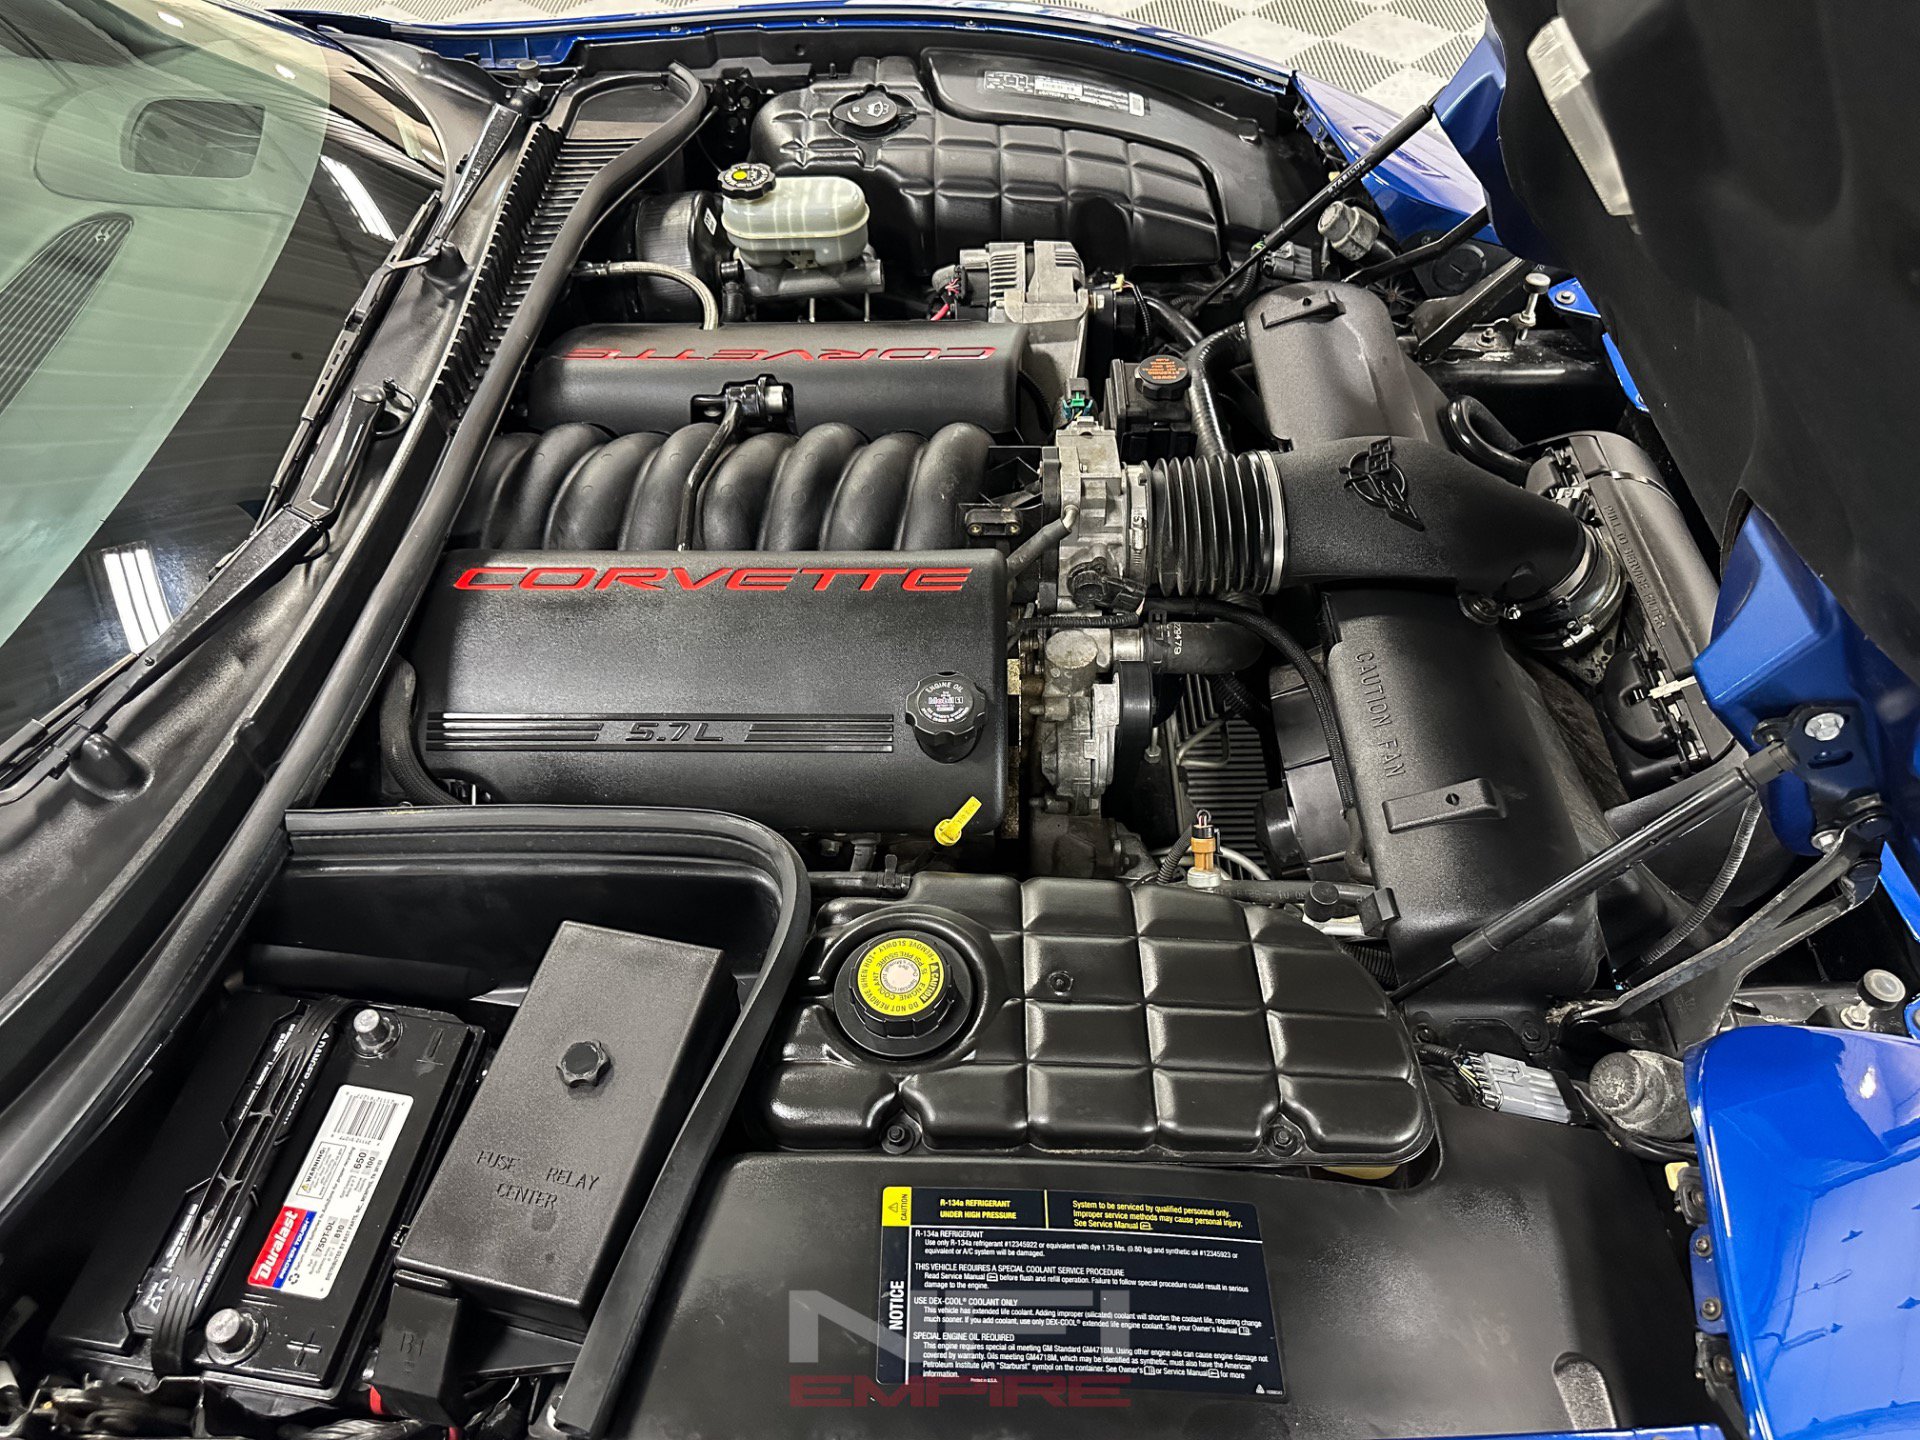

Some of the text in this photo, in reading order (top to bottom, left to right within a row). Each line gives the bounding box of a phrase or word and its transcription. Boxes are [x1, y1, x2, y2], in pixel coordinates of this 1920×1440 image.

[1327, 159, 1367, 193] STABILUS
[561, 347, 996, 362] CORVETTE
[1603, 503, 1621, 531] PULL
[1621, 547, 1649, 592] SERVICE
[1643, 591, 1668, 631] FILTER
[452, 566, 973, 592] CORVETTE
[925, 682, 964, 693] ENGINE OIL
[1354, 651, 1407, 779] CAUTION FAN
[624, 722, 724, 743] 5.7L
[879, 940, 935, 959] REMOVE SLOWLY
[864, 955, 875, 968] HOT
[876, 951, 914, 968] PRESSURE
[873, 972, 896, 1001] COOLANT
[900, 982, 926, 1001] ENGINE
[921, 972, 940, 1002] CAUTION
[864, 989, 890, 1011] REMOVE
[908, 1001, 919, 1010] DO
[305, 1146, 326, 1182] WARNING:
[476, 1151, 600, 1191] FUSE RELAY
[315, 1219, 335, 1252] 75DT-DL
[352, 1151, 368, 1169] 650
[333, 1155, 376, 1238] 810 100
[496, 1183, 558, 1210] CENTER
[965, 1200, 1010, 1208] REFRIGERANT
[900, 1193, 908, 1222] CAUTION
[981, 1211, 1016, 1219] PRESSURE
[1072, 1201, 1097, 1210] System
[1116, 1203, 1144, 1211] serviced
[1145, 1205, 1153, 1213] by
[1154, 1205, 1182, 1214] qualified
[1183, 1207, 1214, 1217] personnel
[1215, 1209, 1231, 1218] only.
[1072, 1210, 1103, 1219] Improper
[1129, 1213, 1157, 1221] methods
[1194, 1217, 1222, 1227] personal
[1222, 1219, 1243, 1228] injury.
[1087, 1220, 1113, 1228] Service
[1113, 1221, 1138, 1229] Manual
[939, 1230, 984, 1238] REFRIGERANT
[252, 1209, 299, 1282] Duralast
[278, 1220, 310, 1279] PROVEN TOUGH
[924, 1247, 954, 1256] equivalent
[974, 1248, 995, 1257] system
[1016, 1249, 1045, 1258] damaged.
[936, 1239, 949, 1247] only
[973, 1239, 1003, 1248] refrigerant
[1004, 1240, 1037, 1248] #12345922
[1045, 1242, 1075, 1251] equivalent
[1089, 1243, 1100, 1252] dye
[1127, 1245, 1142, 1254] (0.80
[1143, 1246, 1152, 1255] kg)
[1165, 1247, 1190, 1257] synthetic
[1199, 1249, 1231, 1258] #12345923
[1085, 1268, 1124, 1276] PROCEDURE
[924, 1280, 947, 1289] damage
[967, 1282, 989, 1291] engine.
[1061, 1276, 1090, 1285] operation.
[1118, 1278, 1136, 1286] follow
[1137, 1279, 1158, 1288] special
[1158, 1280, 1187, 1290] procedure
[1227, 1284, 1249, 1292] serious
[888, 1280, 905, 1331] NOTICE
[928, 1297, 966, 1305] DEX-COOL®
[912, 1331, 940, 1339] SPECIAL
[942, 1332, 967, 1340] ENGINE
[981, 1333, 1014, 1341] REQUIRED
